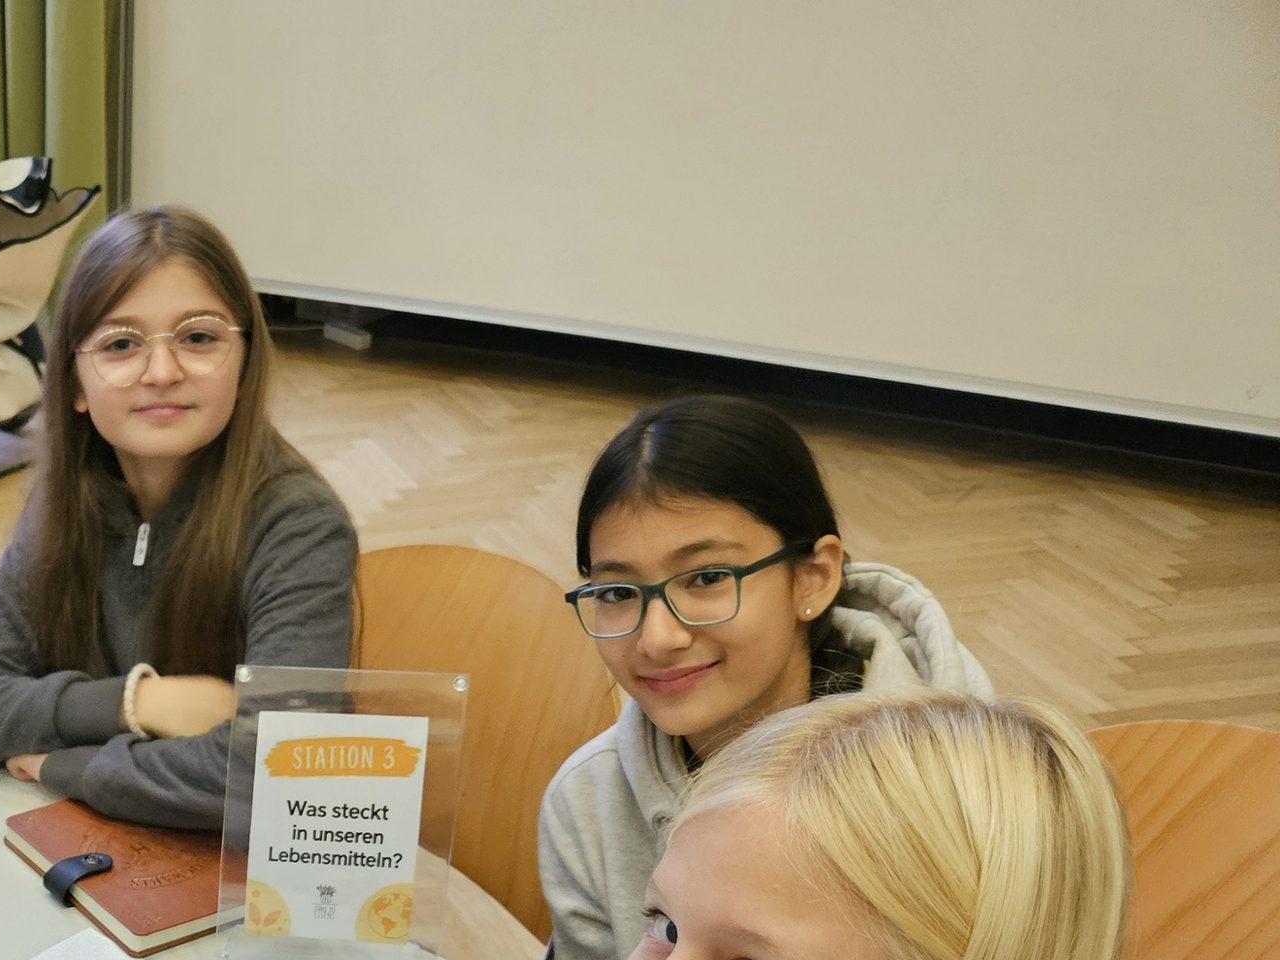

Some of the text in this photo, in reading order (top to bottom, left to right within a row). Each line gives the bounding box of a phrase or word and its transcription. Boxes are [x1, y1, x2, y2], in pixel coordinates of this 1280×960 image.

[292, 745, 396, 769] STATION 3
[287, 800, 389, 820] Was steckt
[292, 825, 384, 845] in unseren
[268, 847, 403, 868] Lebensmitteln?
